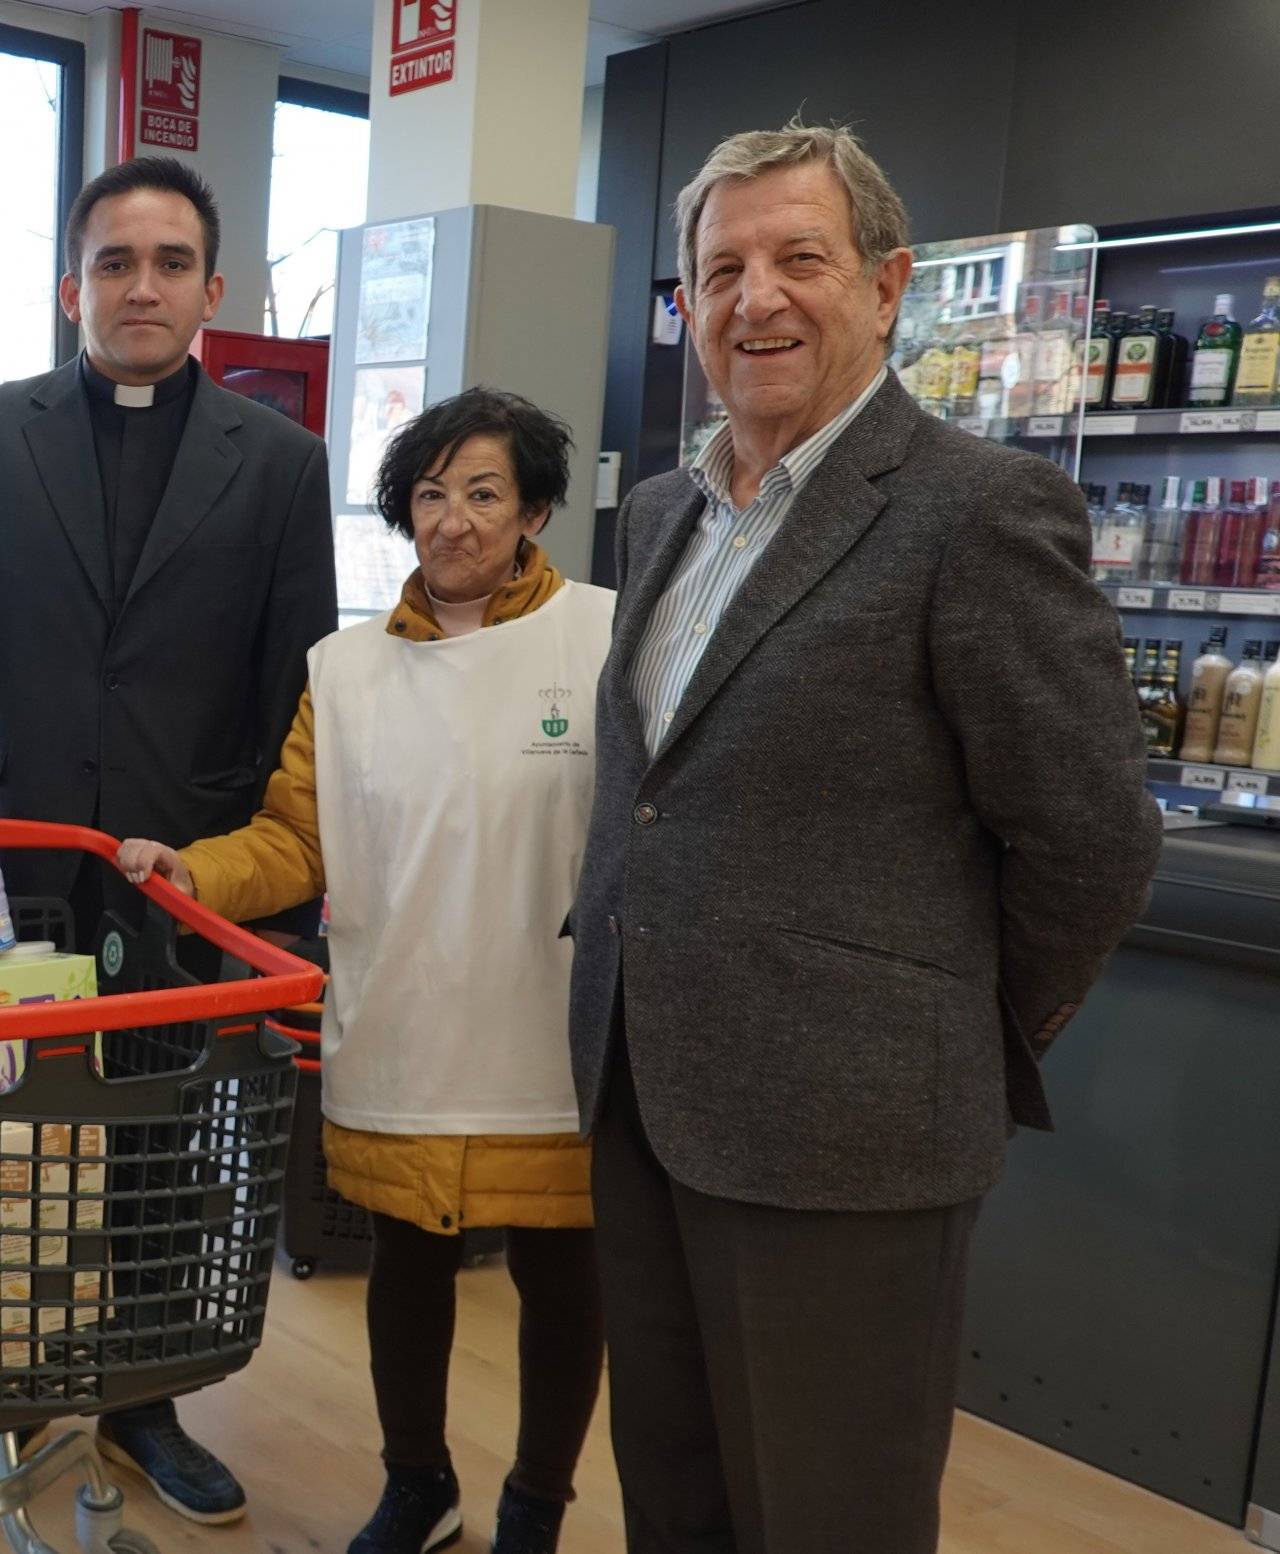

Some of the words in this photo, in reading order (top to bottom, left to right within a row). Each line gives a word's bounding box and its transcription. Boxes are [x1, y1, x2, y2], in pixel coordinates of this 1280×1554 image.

[392, 49, 453, 87] EXTINTOR
[147, 115, 176, 131] BOCA
[177, 120, 192, 133] DE
[144, 129, 194, 147] INCENDIO
